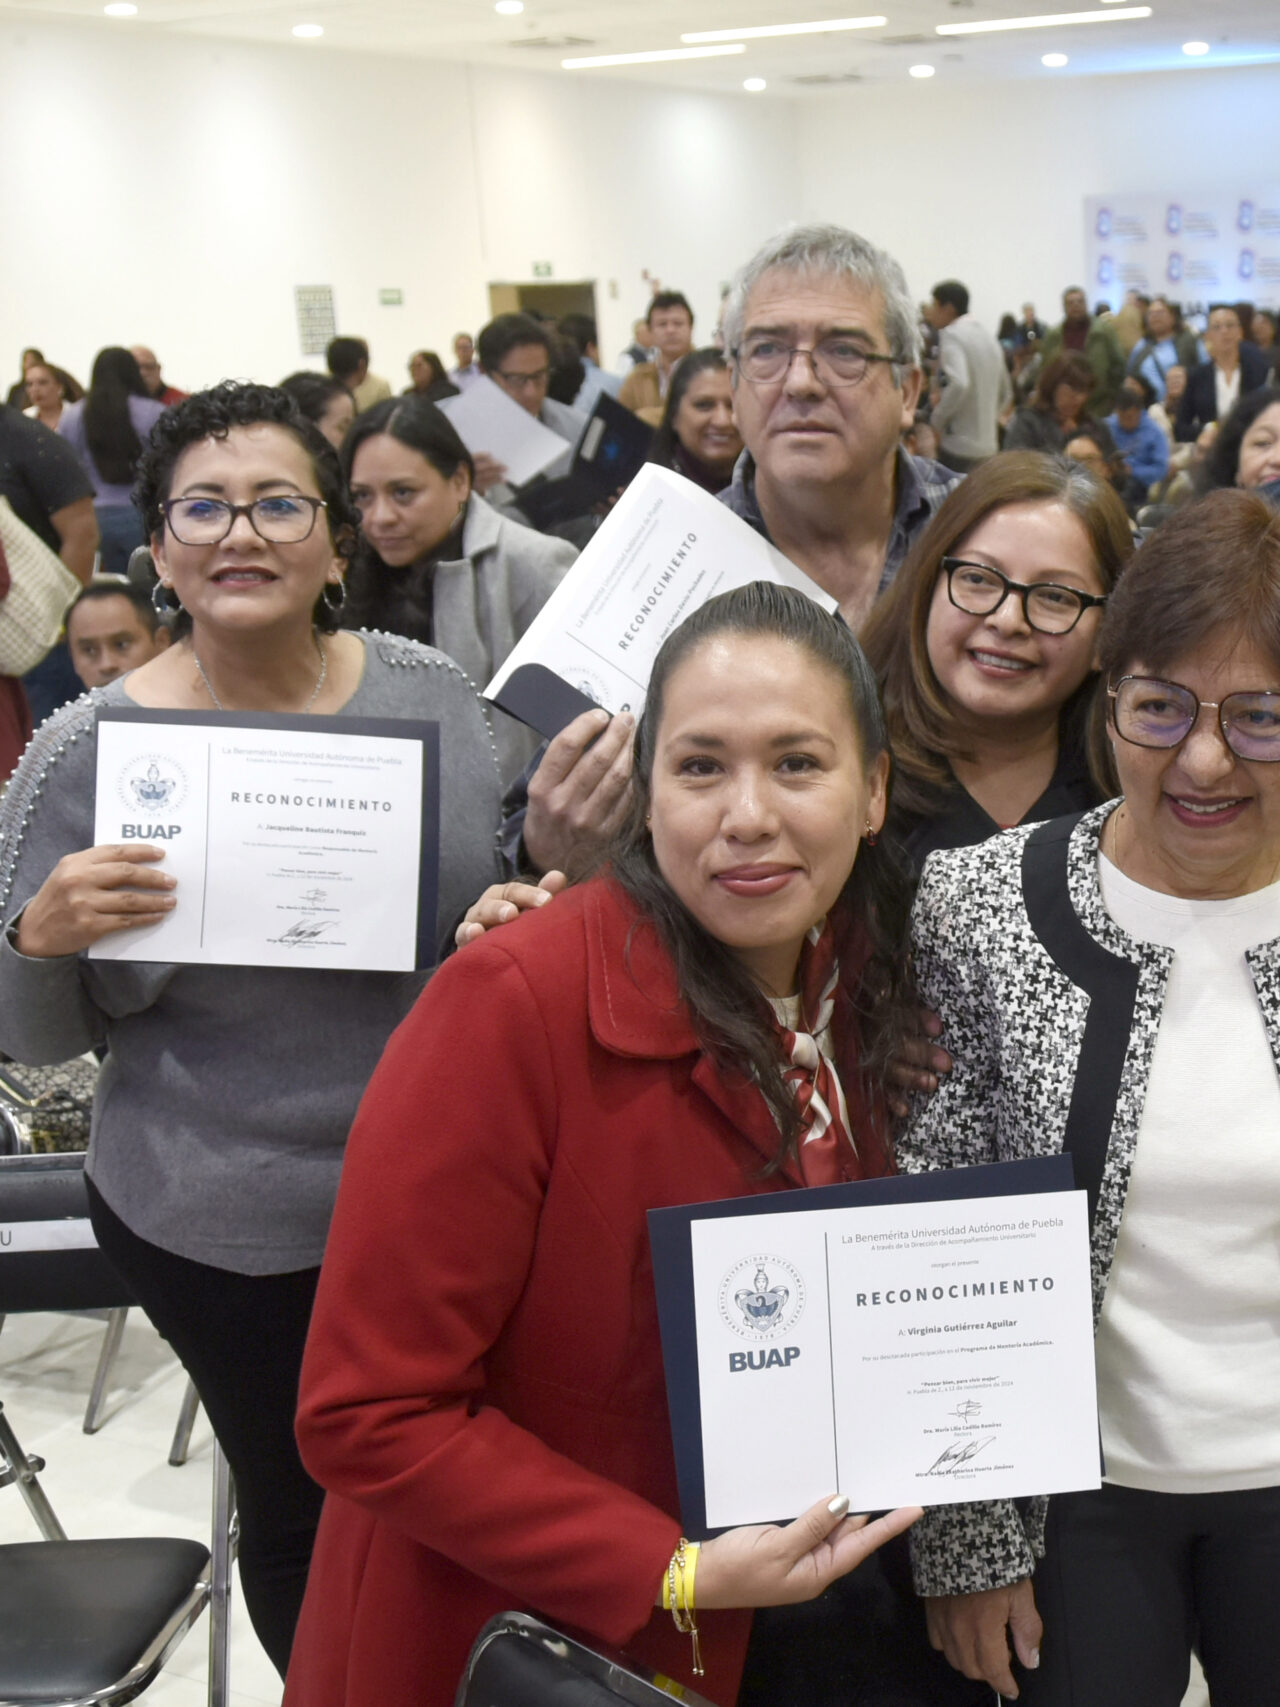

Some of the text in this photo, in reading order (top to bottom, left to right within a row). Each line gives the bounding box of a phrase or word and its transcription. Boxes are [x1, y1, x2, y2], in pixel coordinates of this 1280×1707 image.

[618, 532, 697, 650] RECONOCIMIENTO
[231, 792, 392, 812] RECONOCIMIENTO
[121, 824, 182, 840] BUAP
[842, 1217, 1063, 1244] La Benemérita Universidad Autónoma de Puebla
[856, 1277, 1054, 1307] RECONOCIMIENTO
[908, 1325, 942, 1337] Virginia
[944, 1322, 984, 1333] Gutiérrez
[986, 1319, 1017, 1330] Aguilar
[729, 1346, 800, 1373] BUAP
